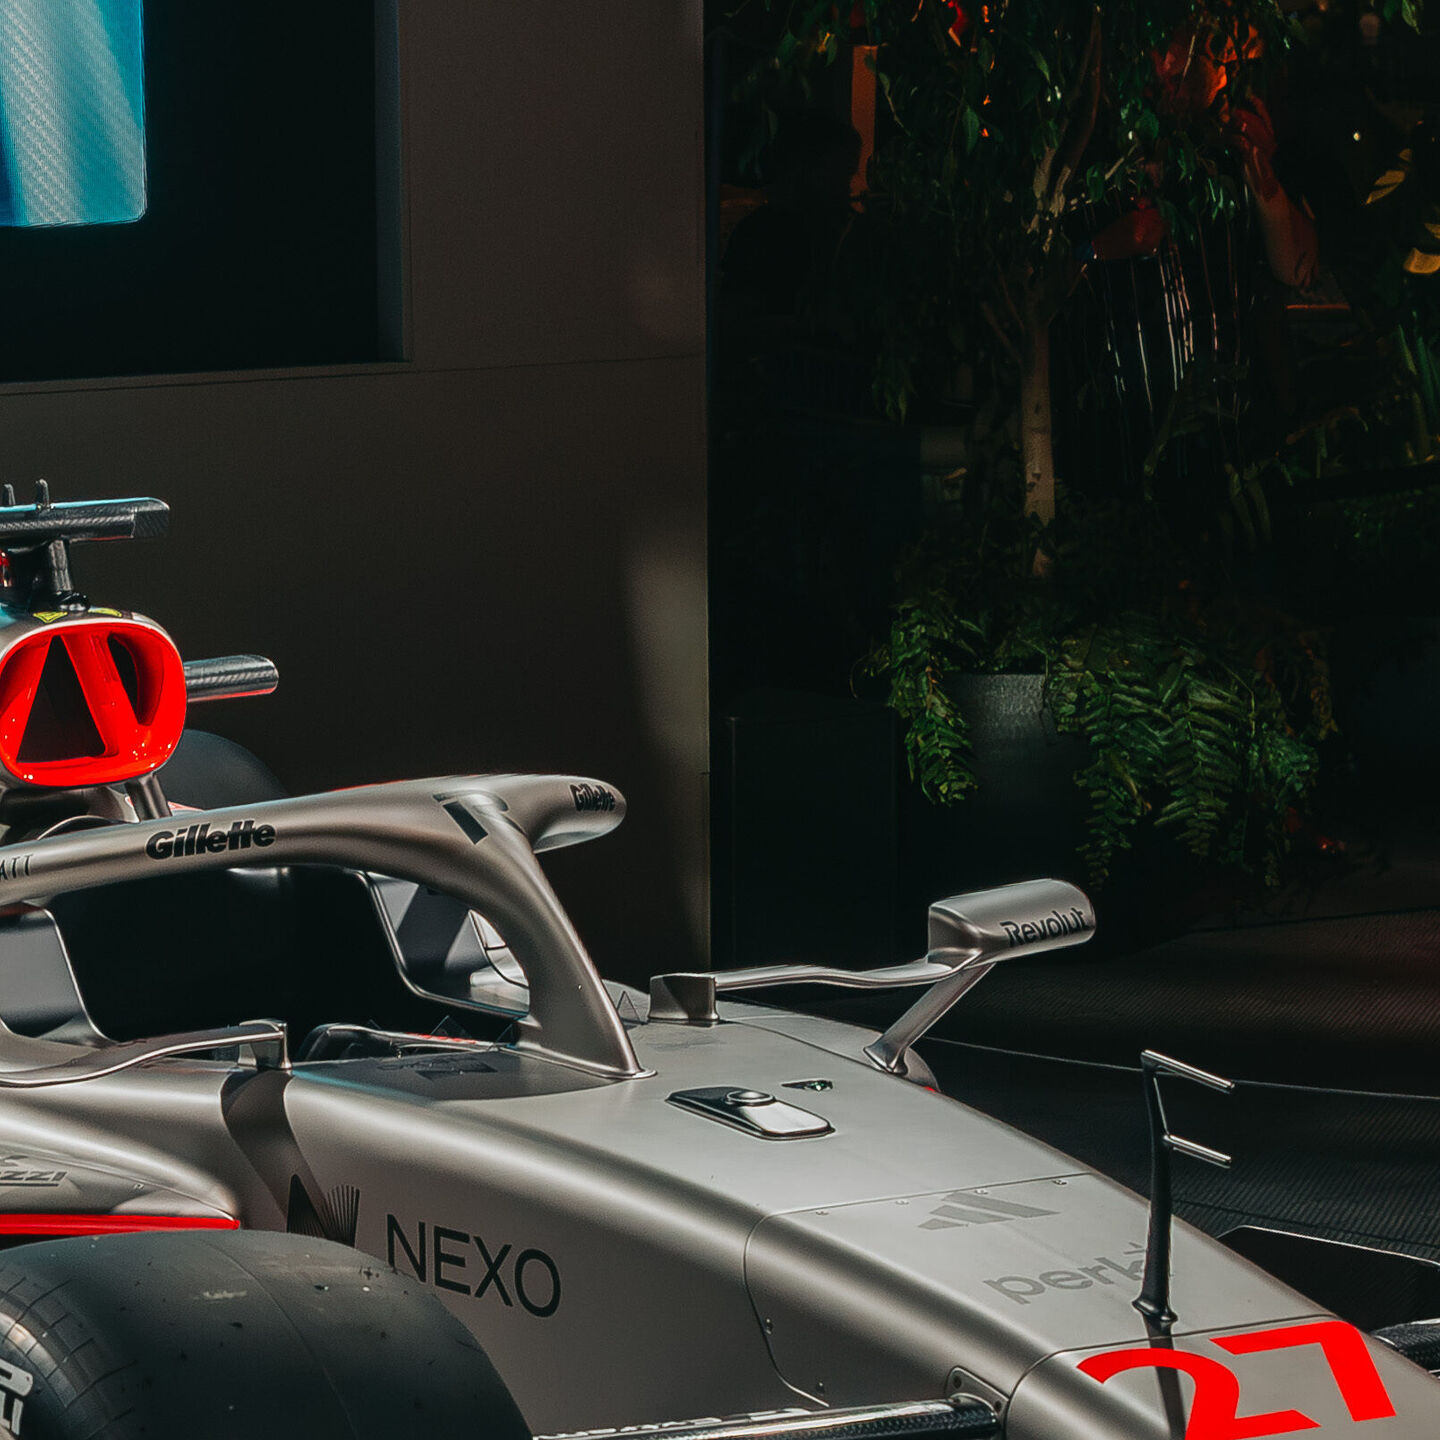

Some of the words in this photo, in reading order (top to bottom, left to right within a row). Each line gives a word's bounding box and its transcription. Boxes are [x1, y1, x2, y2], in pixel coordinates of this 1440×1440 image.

[145, 819, 277, 861] Gillette
[999, 907, 1087, 948] Revolut
[387, 1213, 562, 1318] NEXO
